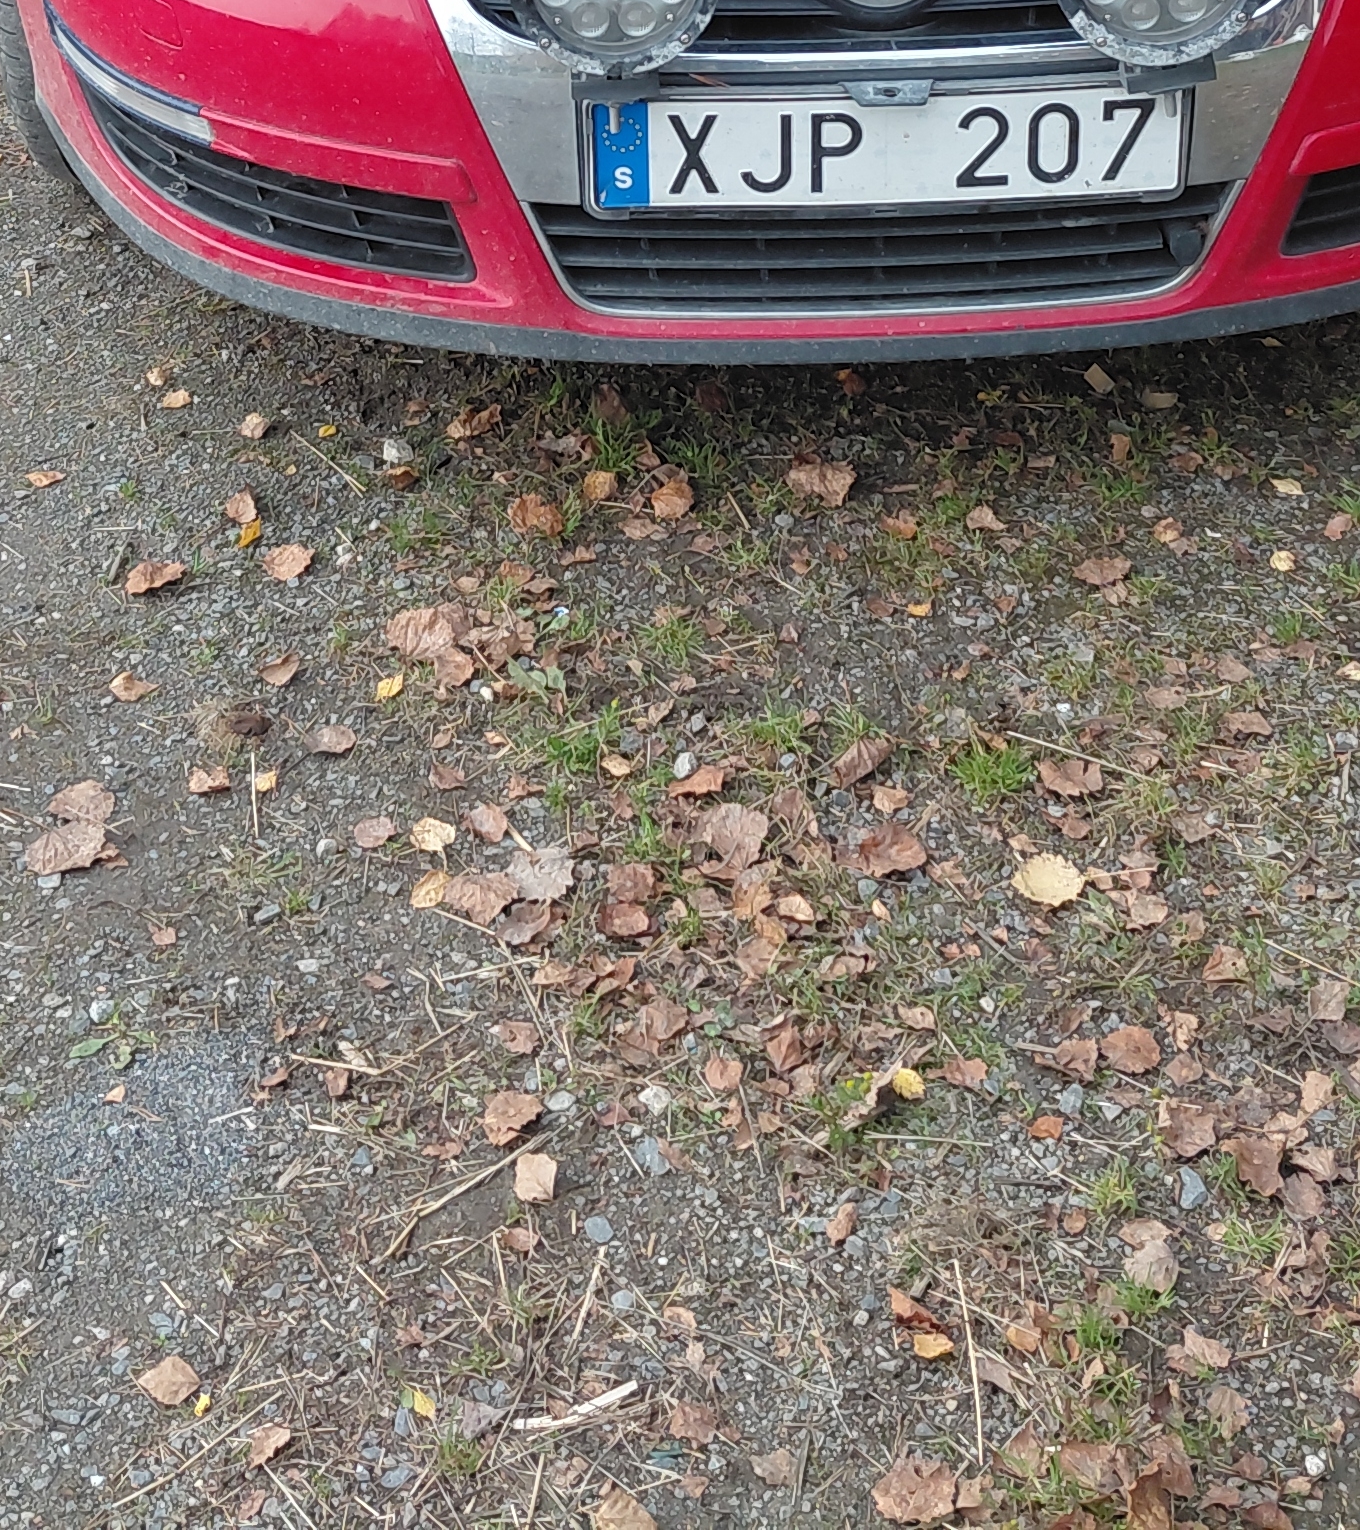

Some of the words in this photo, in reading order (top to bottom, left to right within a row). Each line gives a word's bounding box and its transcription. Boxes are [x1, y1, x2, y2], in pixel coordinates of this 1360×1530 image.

[666, 112, 863, 195] XJP
[956, 97, 1156, 188] 207
[614, 166, 633, 189] S
